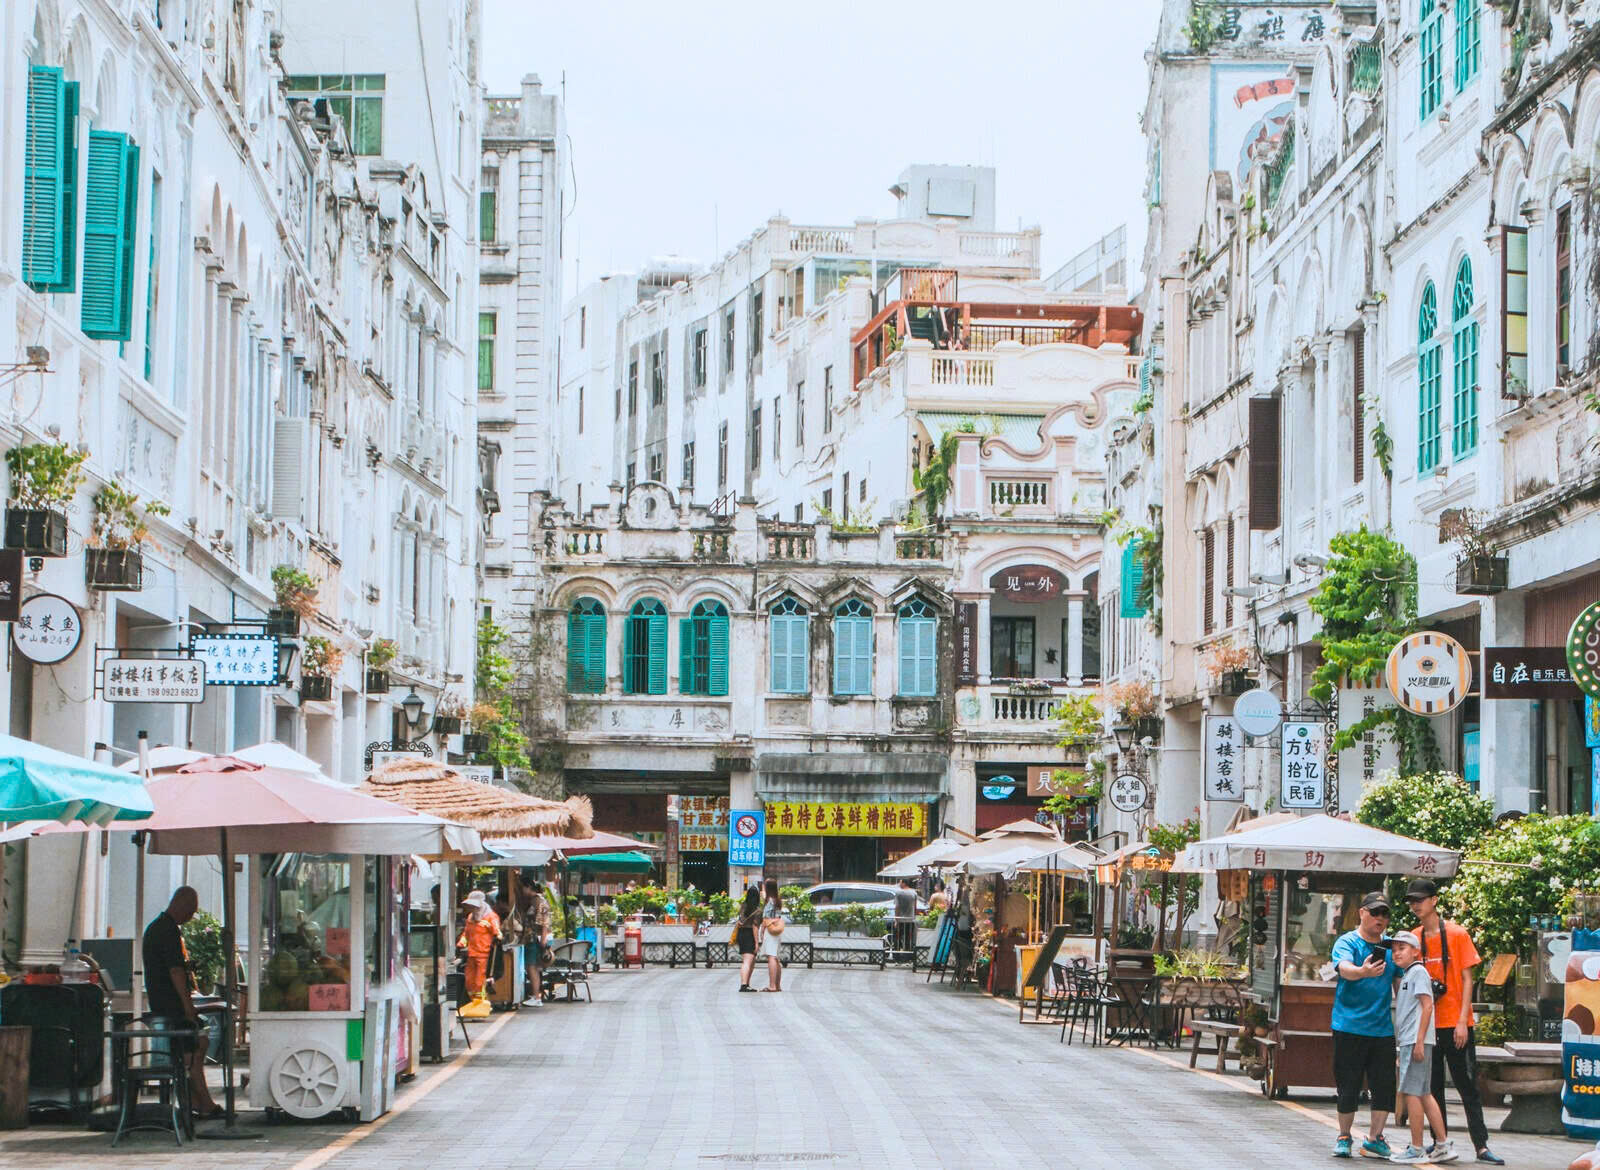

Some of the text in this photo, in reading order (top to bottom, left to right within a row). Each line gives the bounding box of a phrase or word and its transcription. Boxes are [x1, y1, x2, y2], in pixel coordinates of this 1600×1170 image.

[109, 665, 200, 685] 骑楼往事饭店
[206, 661, 268, 675] 费体验店
[1492, 662, 1530, 684] 自在
[1215, 722, 1235, 794] 骑楼客栈
[1287, 762, 1319, 778] 拾忆
[1290, 786, 1315, 800] 民宿
[765, 804, 915, 832] 海南特色海鲜糟粕醋
[1254, 847, 1439, 874] 自助体验
